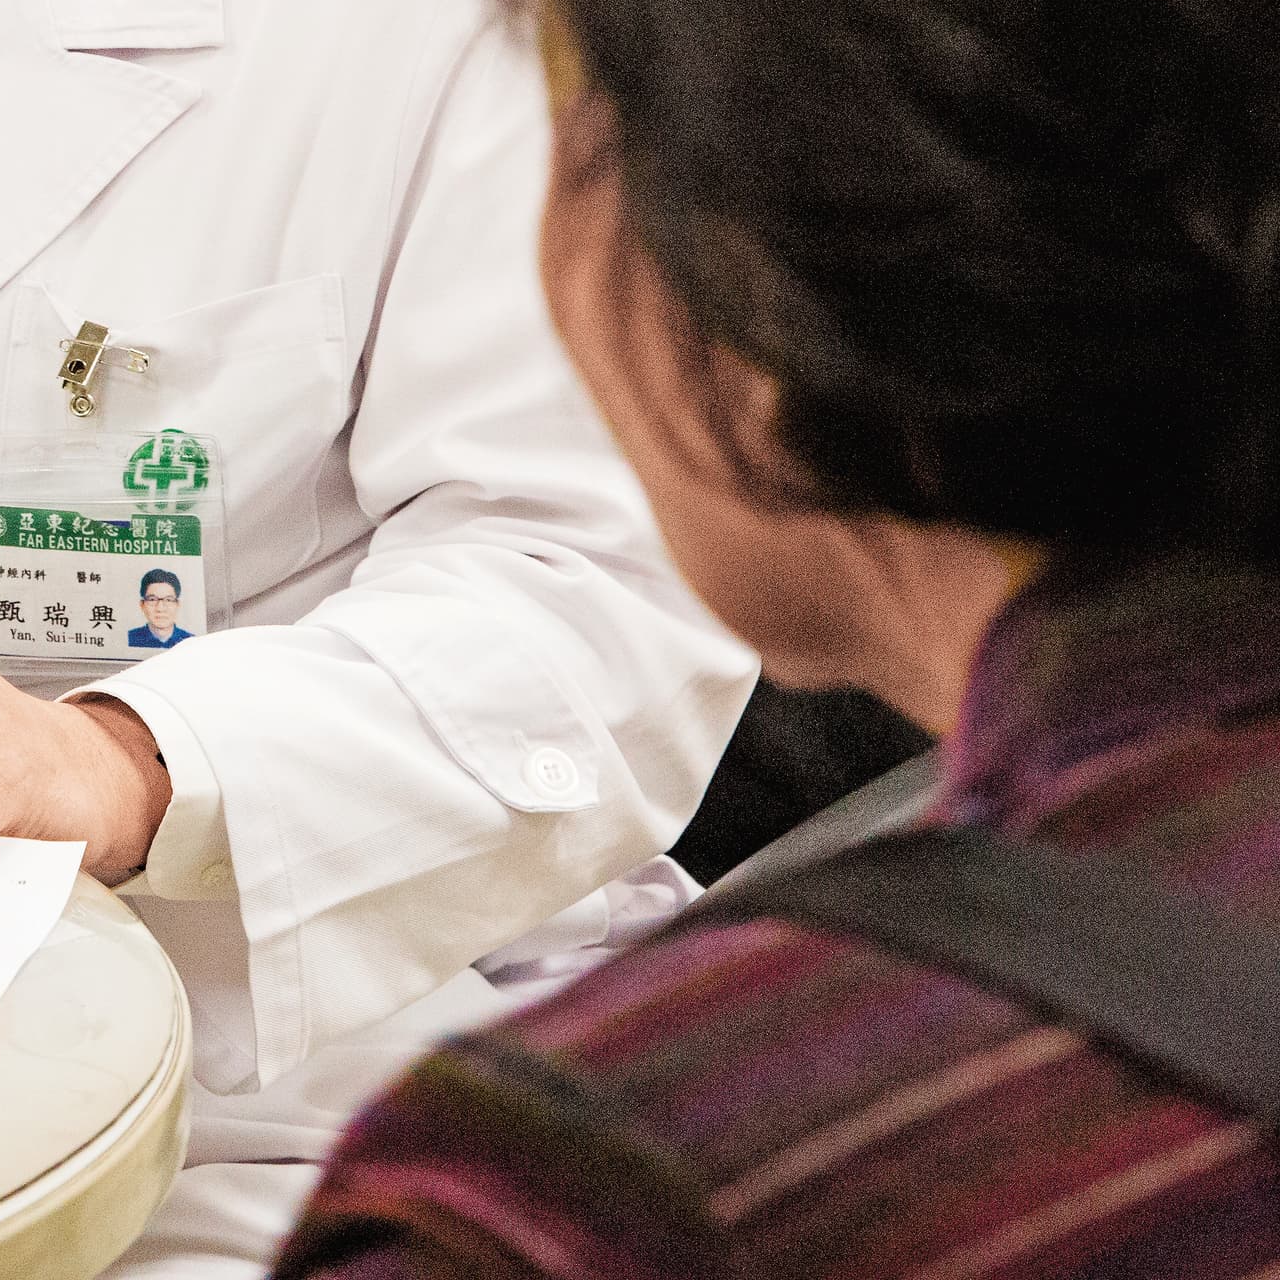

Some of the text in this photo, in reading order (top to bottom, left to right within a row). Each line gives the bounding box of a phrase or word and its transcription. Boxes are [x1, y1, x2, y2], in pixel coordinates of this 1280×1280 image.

[19, 532, 180, 554] FAR EASTERN HOSPITAL
[76, 572, 102, 584] 醫師
[10, 628, 104, 647] Yan, Sui-Hing
